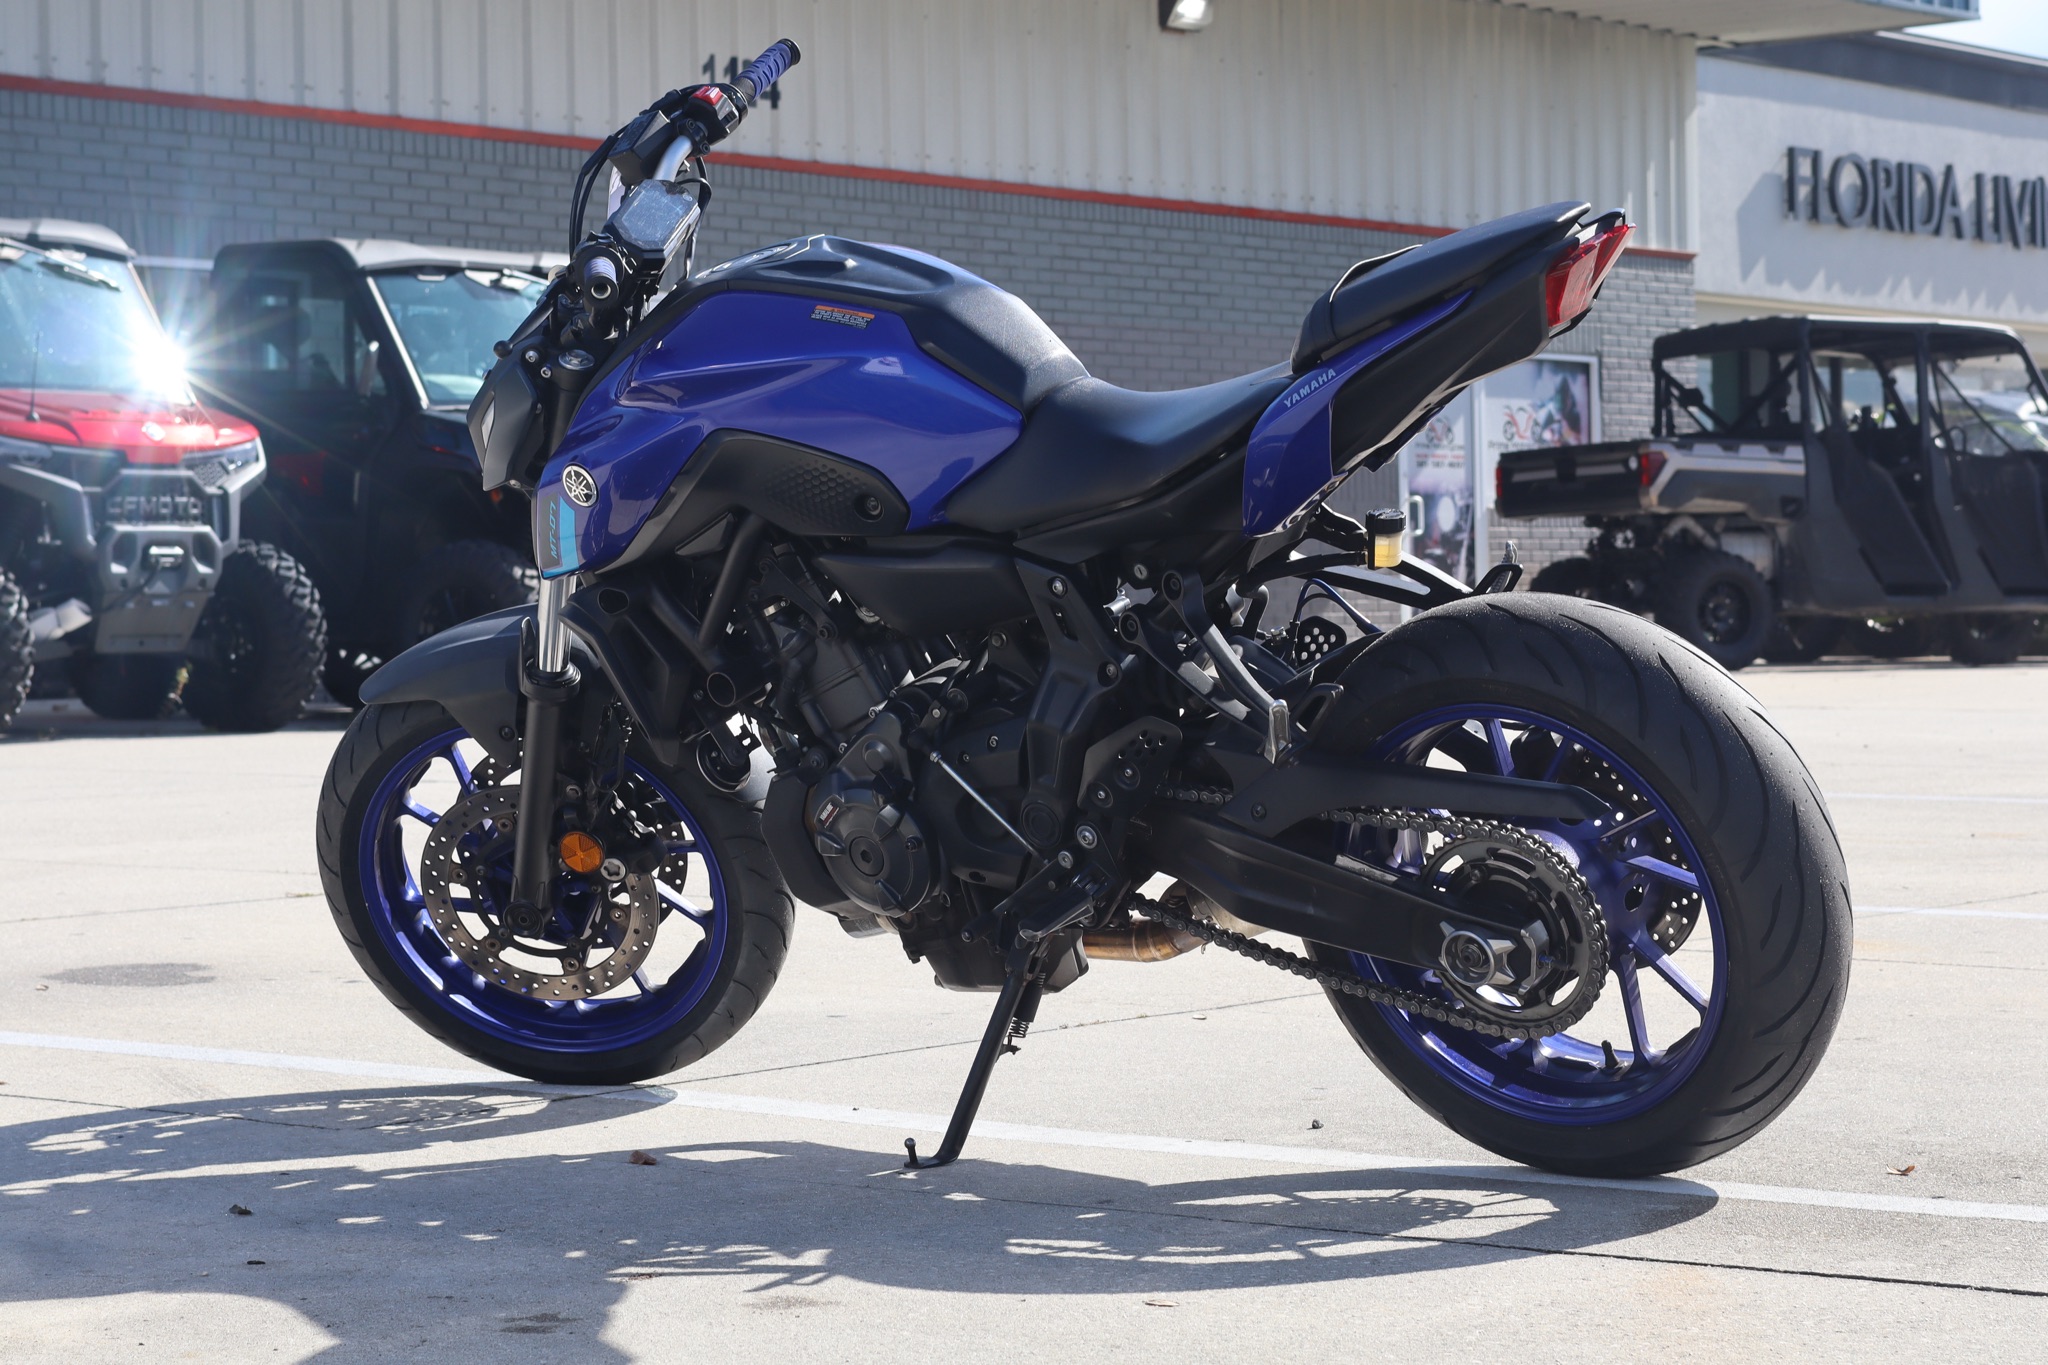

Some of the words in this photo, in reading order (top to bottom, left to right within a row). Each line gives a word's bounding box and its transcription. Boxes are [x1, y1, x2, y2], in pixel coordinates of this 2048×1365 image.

[1787, 146, 1966, 240] FLORIDA
[1283, 368, 1337, 408] YAMAHA
[106, 496, 203, 514] CFMOTO
[549, 501, 558, 559] MT-07
